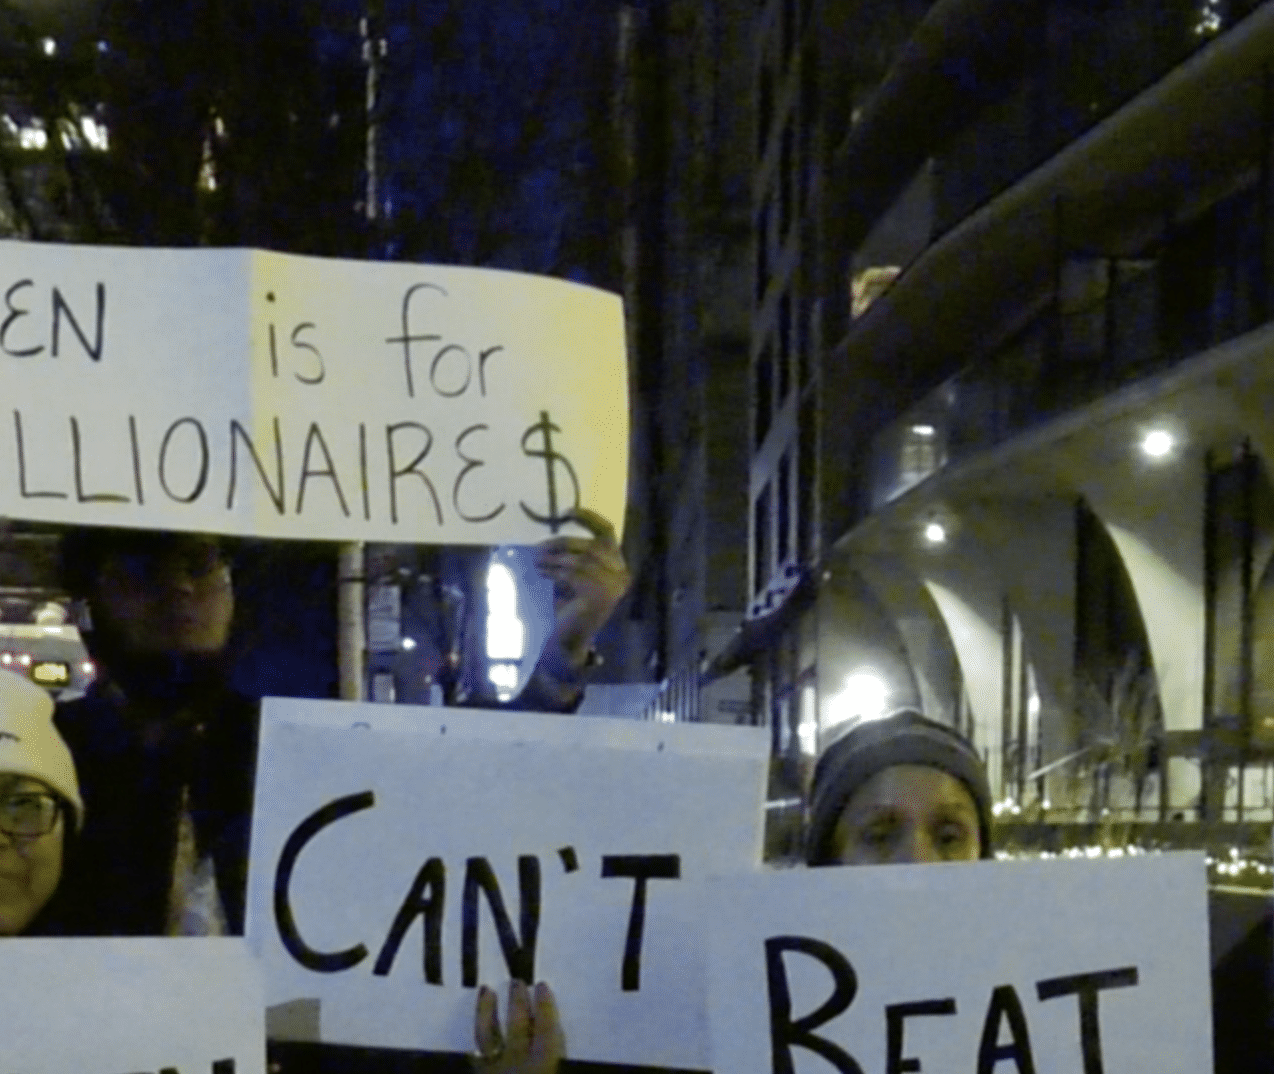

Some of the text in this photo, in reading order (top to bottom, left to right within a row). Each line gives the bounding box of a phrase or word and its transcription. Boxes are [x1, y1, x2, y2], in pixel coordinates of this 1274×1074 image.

[263, 291, 326, 386] is
[385, 282, 505, 400] for
[274, 790, 681, 991] CAN'T
